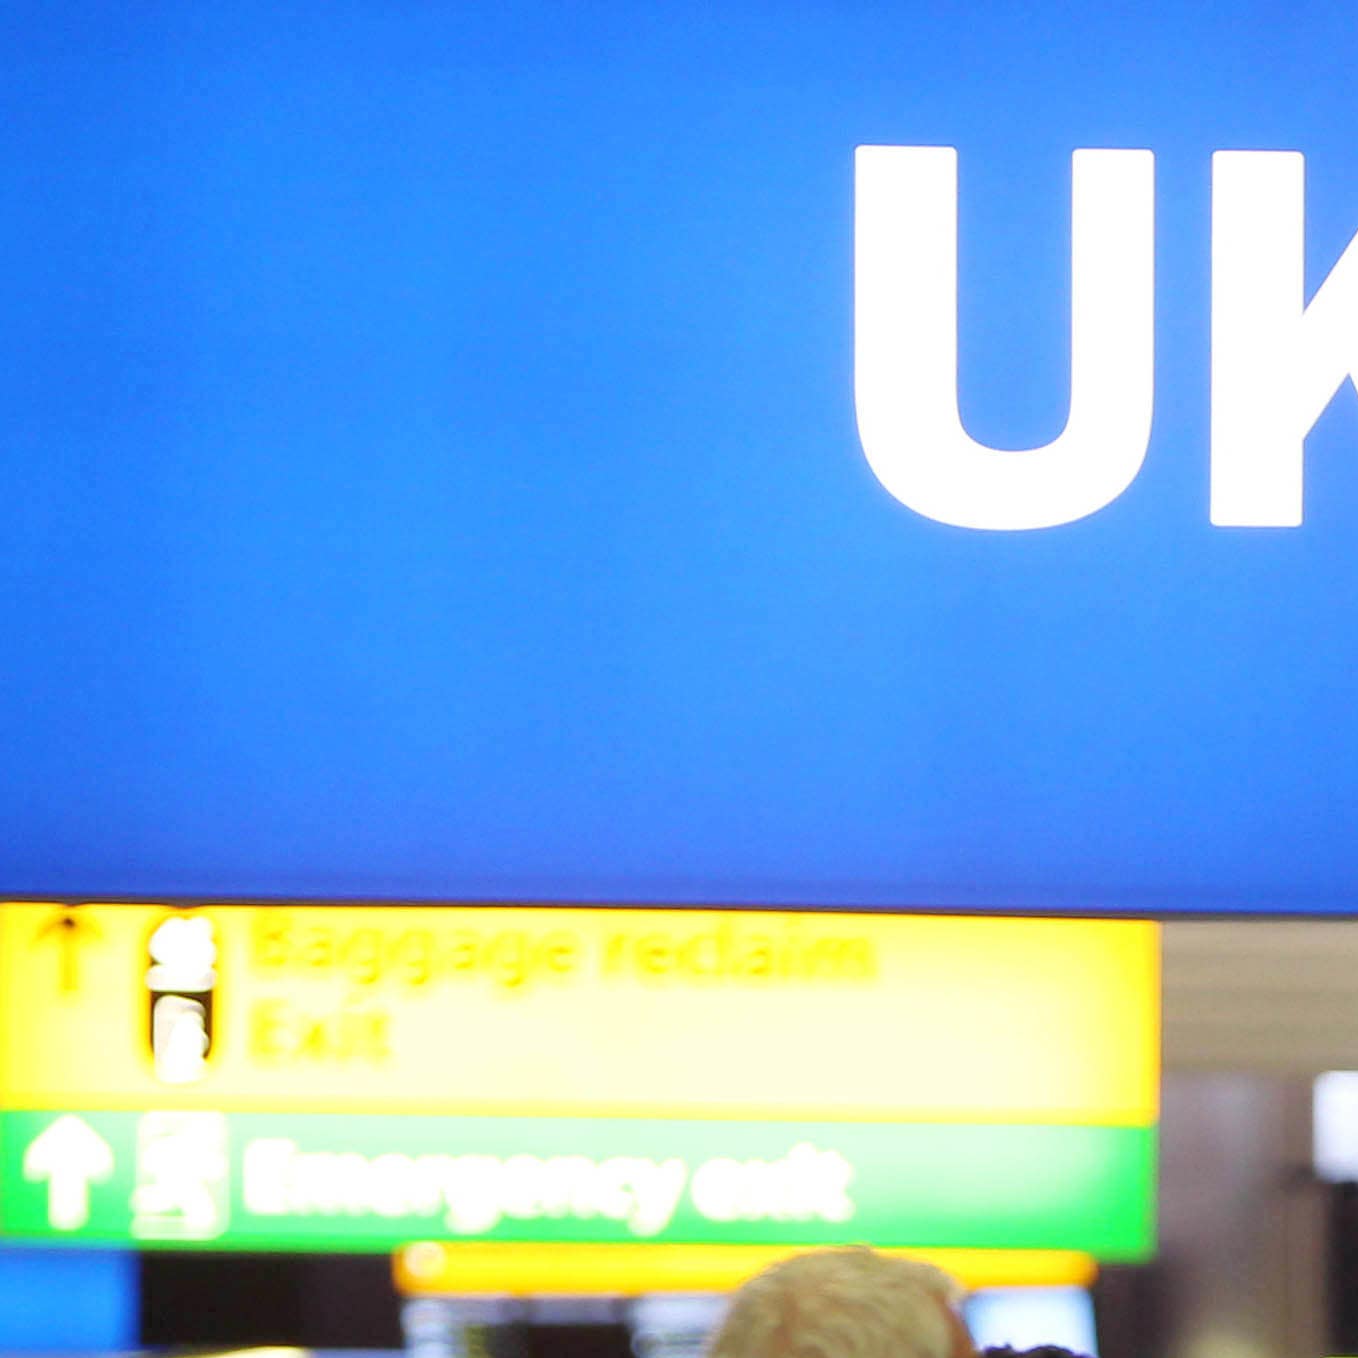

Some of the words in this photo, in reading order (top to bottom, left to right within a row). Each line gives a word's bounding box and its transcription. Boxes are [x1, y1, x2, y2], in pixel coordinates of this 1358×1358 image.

[243, 908, 582, 994] Baggage
[601, 912, 880, 984] reclaim
[247, 998, 394, 1064] Exit
[243, 1138, 688, 1236] Emergency
[691, 1142, 855, 1222] exit
